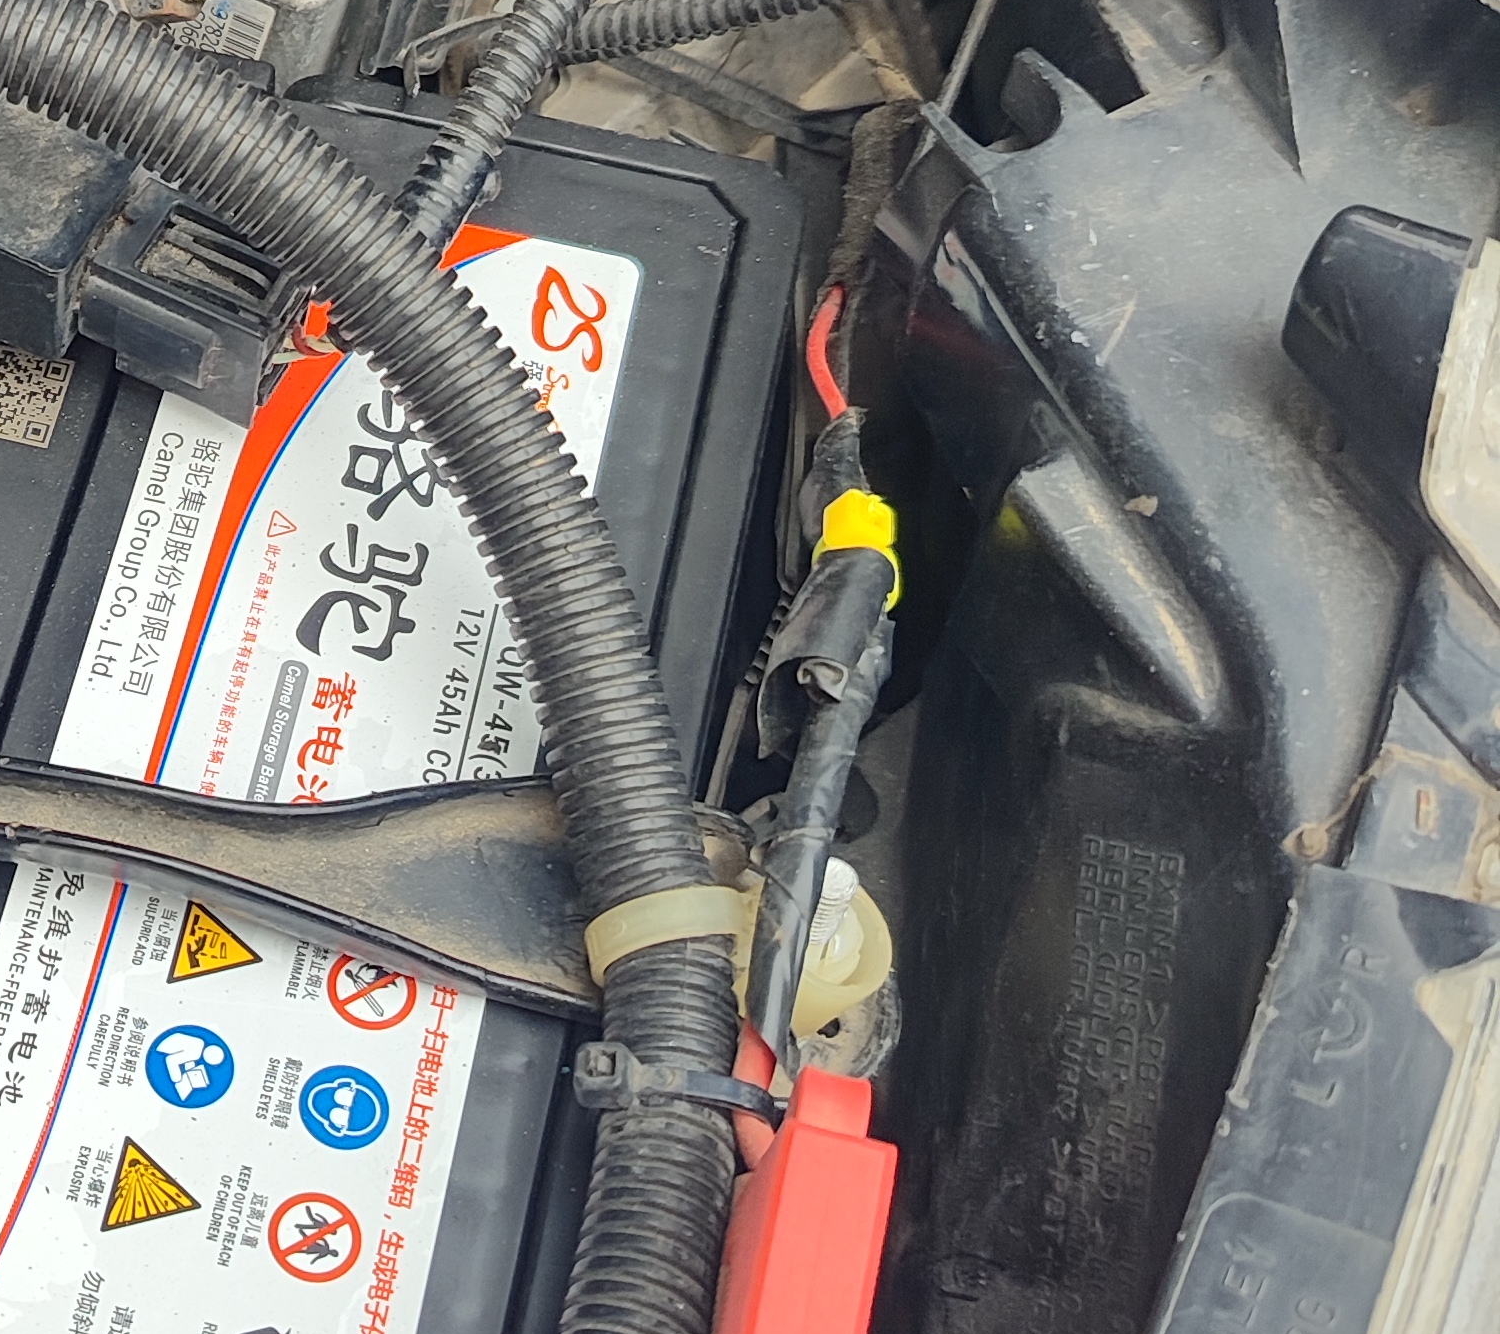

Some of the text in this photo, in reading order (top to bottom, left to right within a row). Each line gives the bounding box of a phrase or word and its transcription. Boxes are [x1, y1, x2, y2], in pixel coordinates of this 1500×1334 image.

[88, 433, 183, 681] Camel Group Co., Ltd.
[123, 438, 224, 695] 骆驼集团股份有限公司
[454, 610, 484, 657] 12V
[279, 666, 301, 709] Camel
[433, 668, 469, 734] 45Ah
[264, 710, 289, 762] Storage
[132, 897, 160, 965] SULFURIC ACID
[150, 908, 178, 961] 当心腐蚀
[286, 939, 311, 998] FLAMMABLE
[302, 944, 331, 998] 禁止烟火
[87, 1014, 110, 1069] CAREFULLY
[98, 1007, 129, 1087] READ DIRECTION
[117, 1017, 148, 1086] 参阅说明书
[256, 1058, 280, 1119] SHIELD EYES
[270, 1057, 302, 1129] 戴防护眼镜
[66, 1146, 91, 1202] EXPLOSIVE
[84, 1150, 113, 1208] 当心爆炸
[206, 1175, 232, 1242] OF CHILDREN
[217, 1165, 252, 1267] KEEP OUT OF REACH
[240, 1192, 268, 1248] 远离儿童
